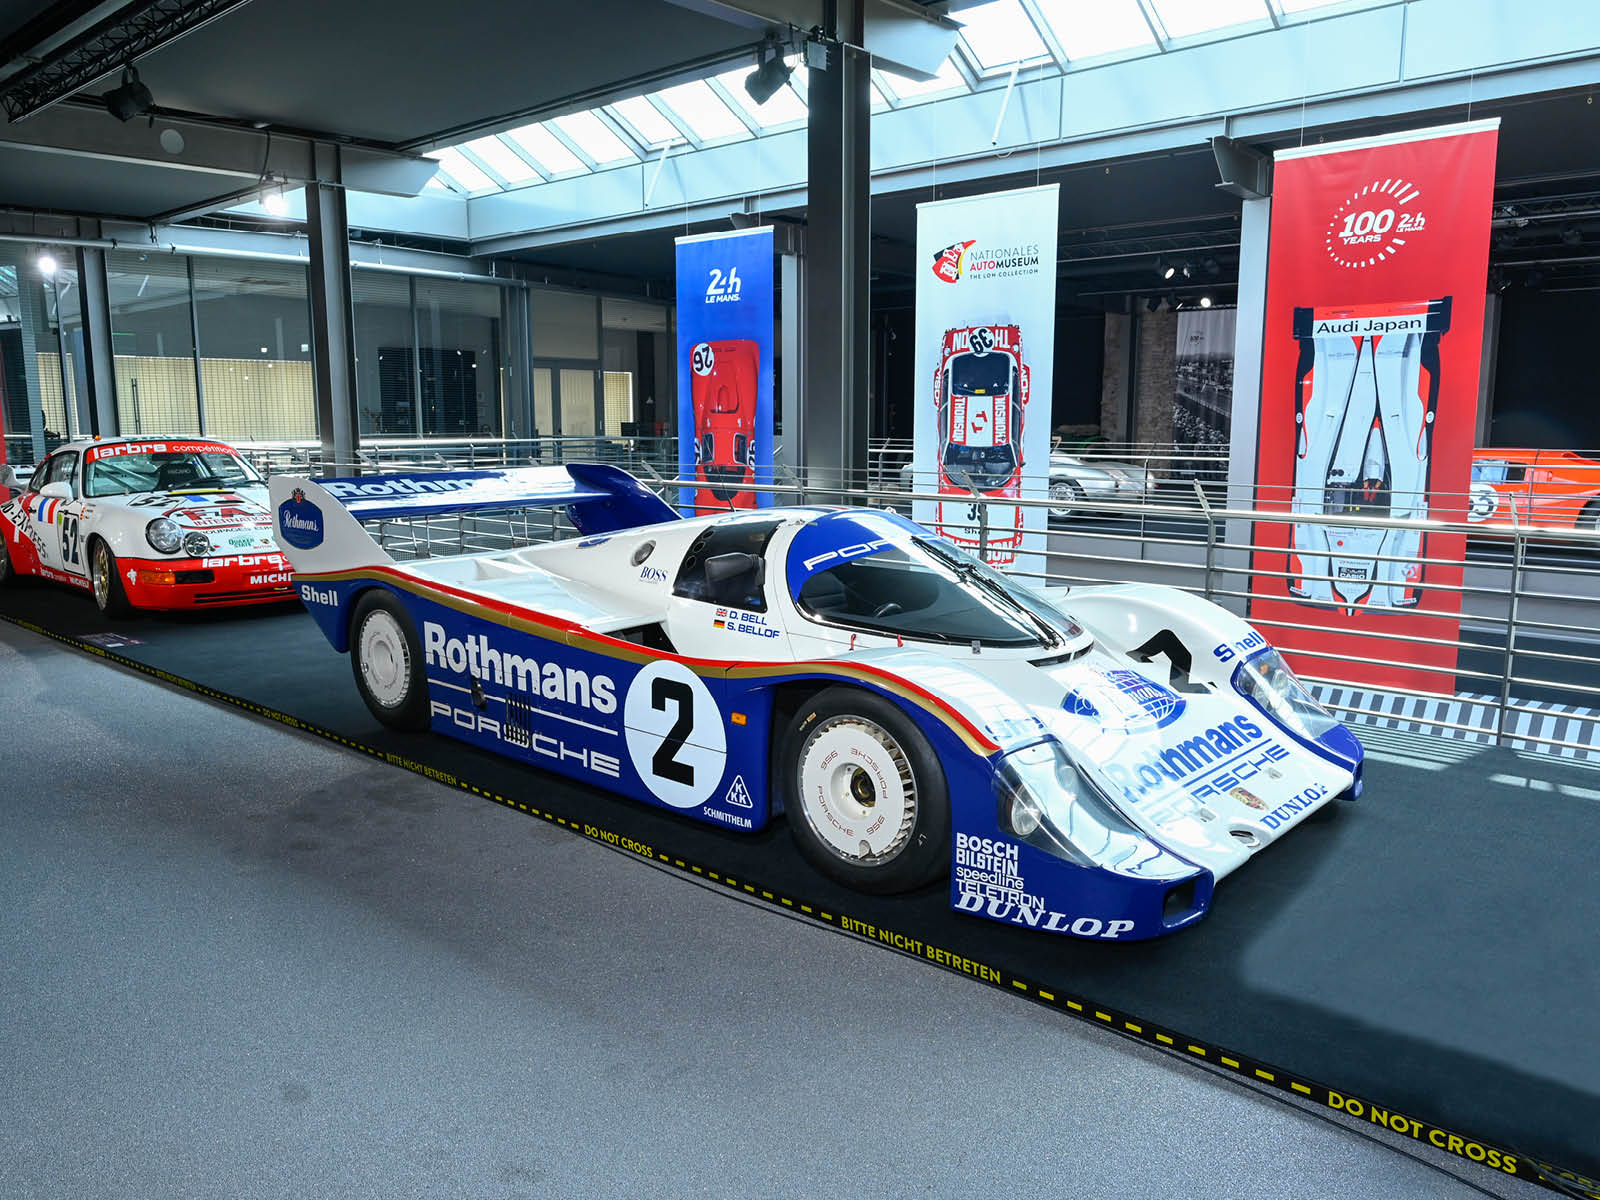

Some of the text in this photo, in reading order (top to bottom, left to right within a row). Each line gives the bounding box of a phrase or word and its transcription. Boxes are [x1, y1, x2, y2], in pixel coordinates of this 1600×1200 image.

[1338, 209, 1395, 238] 100
[970, 244, 1039, 261] NATIONALES
[1343, 234, 1382, 245] YEARS
[970, 256, 1039, 272] AUTOMUSEUM
[998, 268, 1039, 278] COLLECTION
[706, 266, 742, 296] 24h
[705, 293, 740, 304] LE MANS
[1316, 318, 1422, 334] Audi Japan
[93, 443, 167, 460] larbre
[282, 509, 320, 532] Rothmans
[62, 516, 79, 565] 52
[640, 566, 668, 581] BOSS
[301, 584, 338, 606] Shell
[727, 621, 780, 638] S. BELLOF
[729, 610, 767, 626] D. BELL
[424, 621, 618, 714] Rothmans
[430, 700, 620, 778] PORSCHE
[652, 677, 694, 787] 2
[386, 752, 457, 785] BITTE NICHT BETRETEN
[821, 750, 838, 770] 956
[850, 747, 889, 799] PORSCHE
[703, 806, 753, 829] SCHMITTHELM
[817, 785, 854, 837] PORSCHE
[866, 815, 885, 835] 956
[584, 824, 653, 858] DO NOT CROSS
[956, 832, 1019, 861] BOSCH
[956, 848, 1018, 877] BILSTEIN
[956, 866, 1025, 890] speedline
[956, 879, 1045, 911] TELETRON
[954, 891, 1135, 938] DUNLOP
[841, 915, 1001, 985] BITTE NICHT BETRETEN
[1328, 1091, 1517, 1174] DO NOT CROSS
